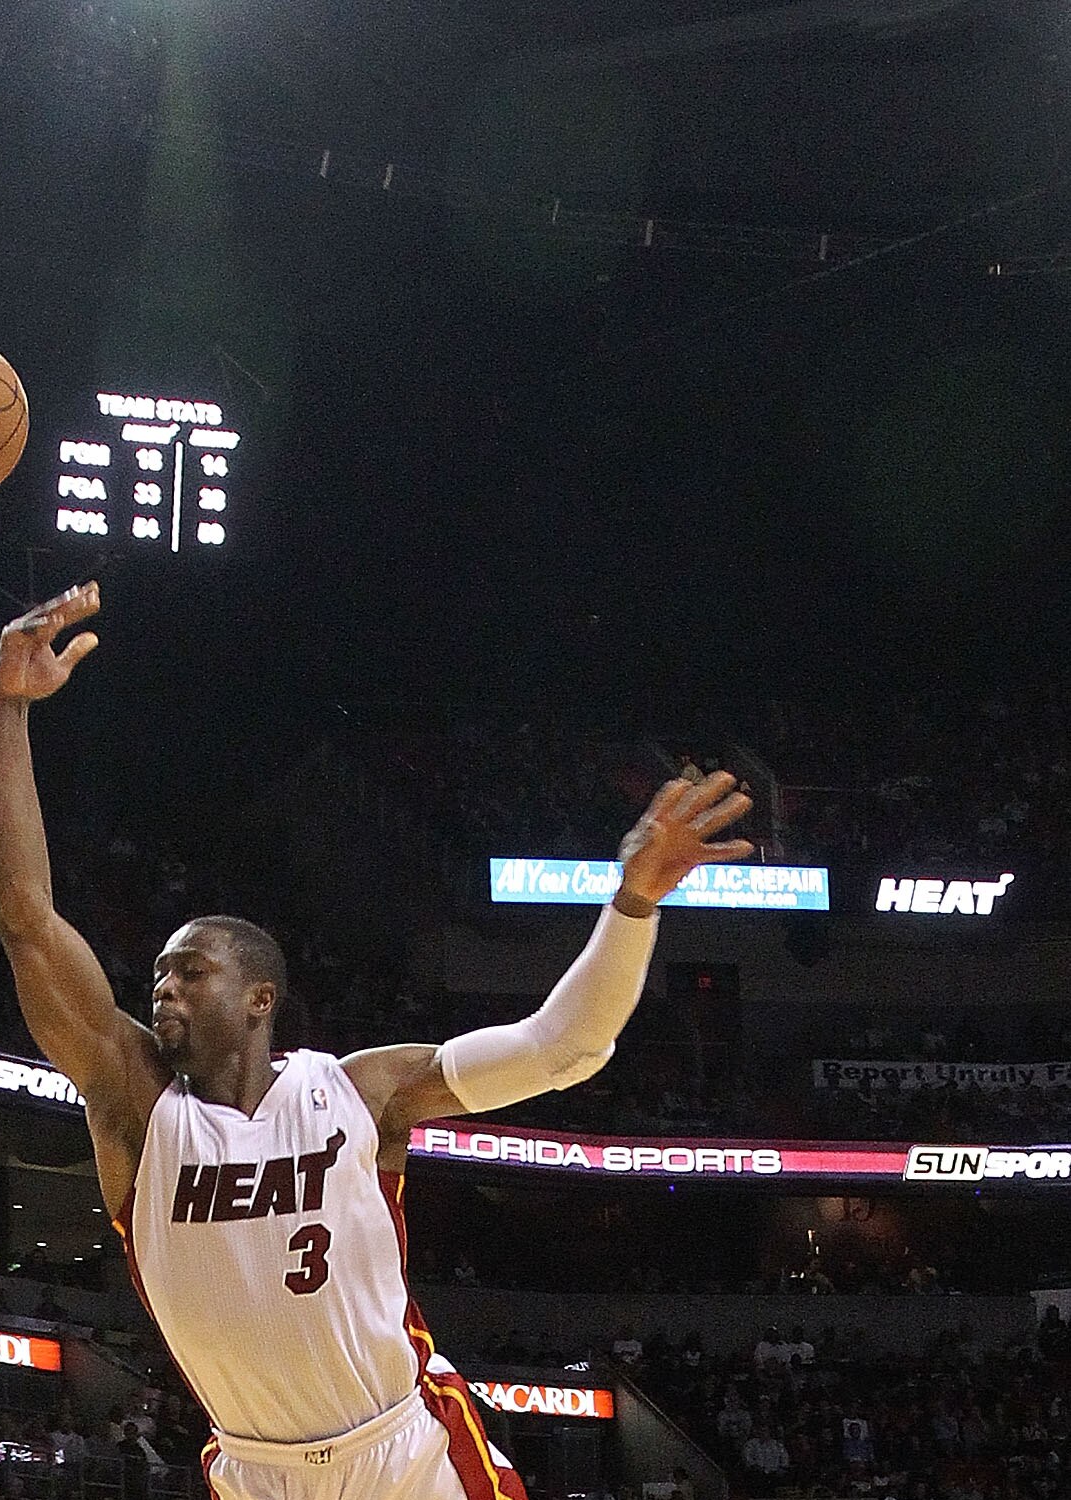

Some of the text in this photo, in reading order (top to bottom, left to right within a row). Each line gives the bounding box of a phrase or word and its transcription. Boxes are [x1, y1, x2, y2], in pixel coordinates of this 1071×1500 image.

[96, 392, 223, 425] TEAM STATS
[59, 440, 111, 467] FGM
[58, 474, 108, 500] FGA
[57, 508, 109, 535] FG%
[713, 867, 823, 893] AC-REPAIR
[876, 872, 1015, 915] HEAT
[822, 1061, 926, 1086] Report
[934, 1064, 1034, 1087] Unruly
[424, 1128, 783, 1174] FLORIDA SPORTS
[914, 1153, 981, 1175] SUN
[171, 1127, 347, 1224] HEAT
[283, 1222, 333, 1297] 3
